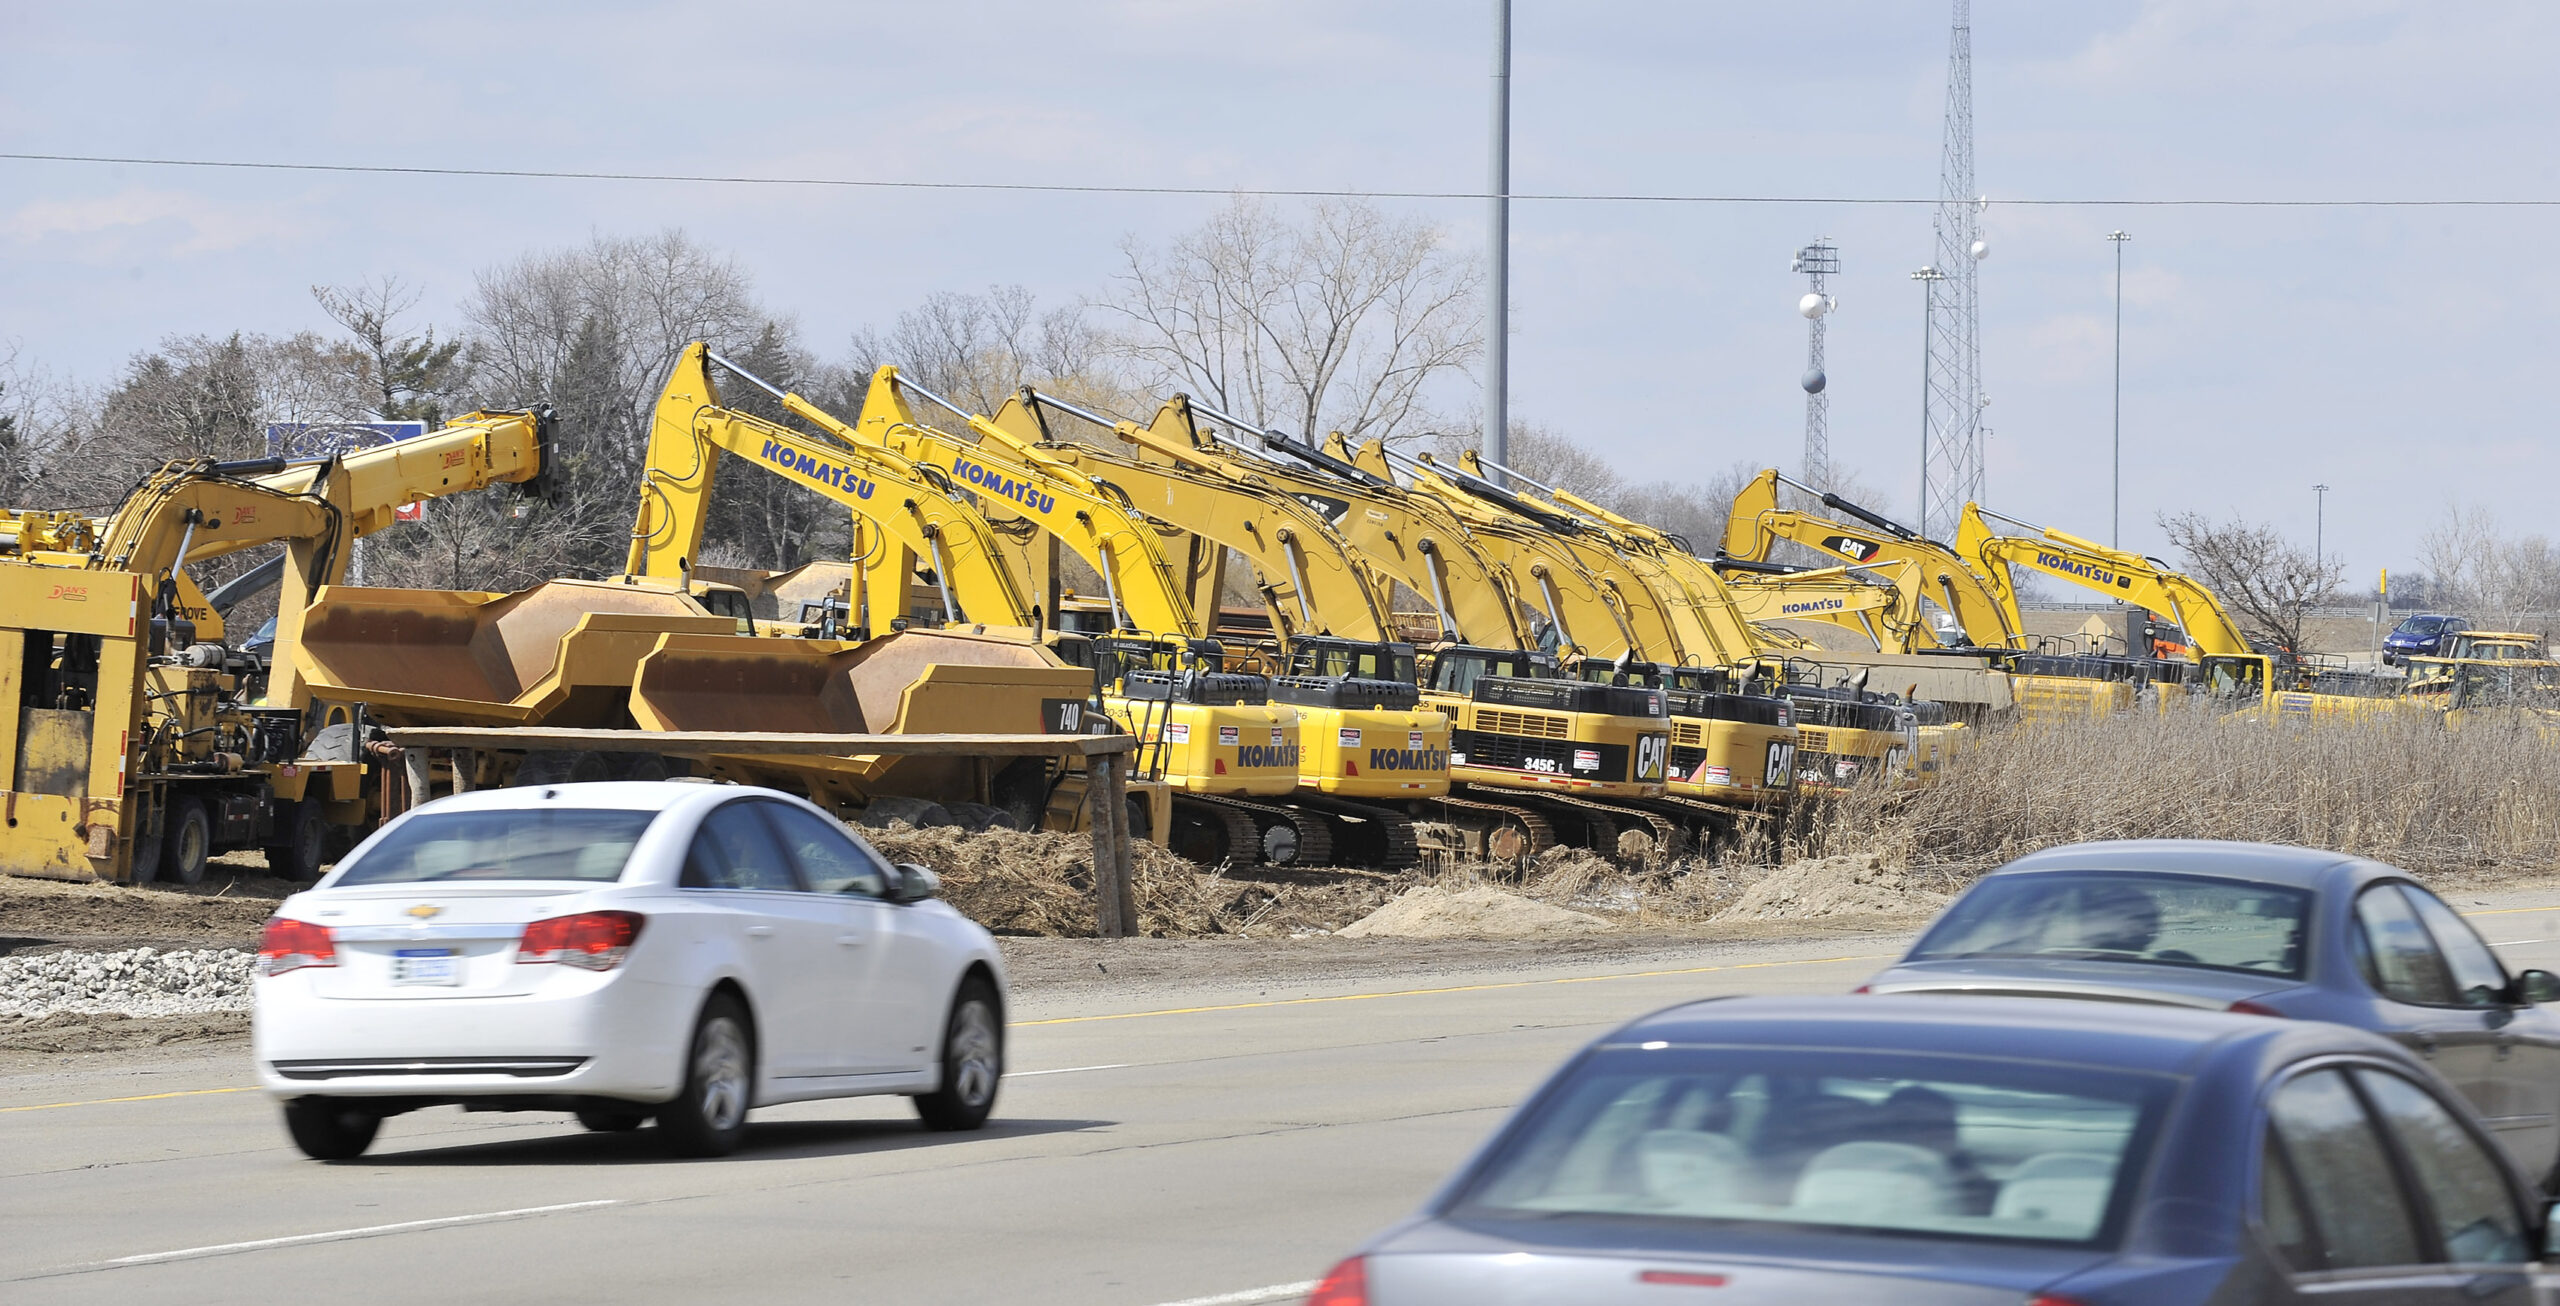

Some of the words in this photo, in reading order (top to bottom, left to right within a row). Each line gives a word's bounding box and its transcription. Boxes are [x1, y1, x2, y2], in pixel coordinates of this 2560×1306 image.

[761, 439, 876, 500] KOMATSU
[952, 457, 1055, 514] KOMATSU
[1839, 538, 1866, 560] CAT
[2037, 552, 2114, 584] KOMATSU
[1782, 598, 1843, 614] KOMATSU
[1060, 703, 1079, 731] 740
[1238, 739, 1299, 768] KOMATS
[1370, 744, 1448, 771] KOMATSU
[1524, 757, 1556, 773] 345C
[1637, 736, 1667, 779] CAT
[1766, 743, 1795, 786] CAT
